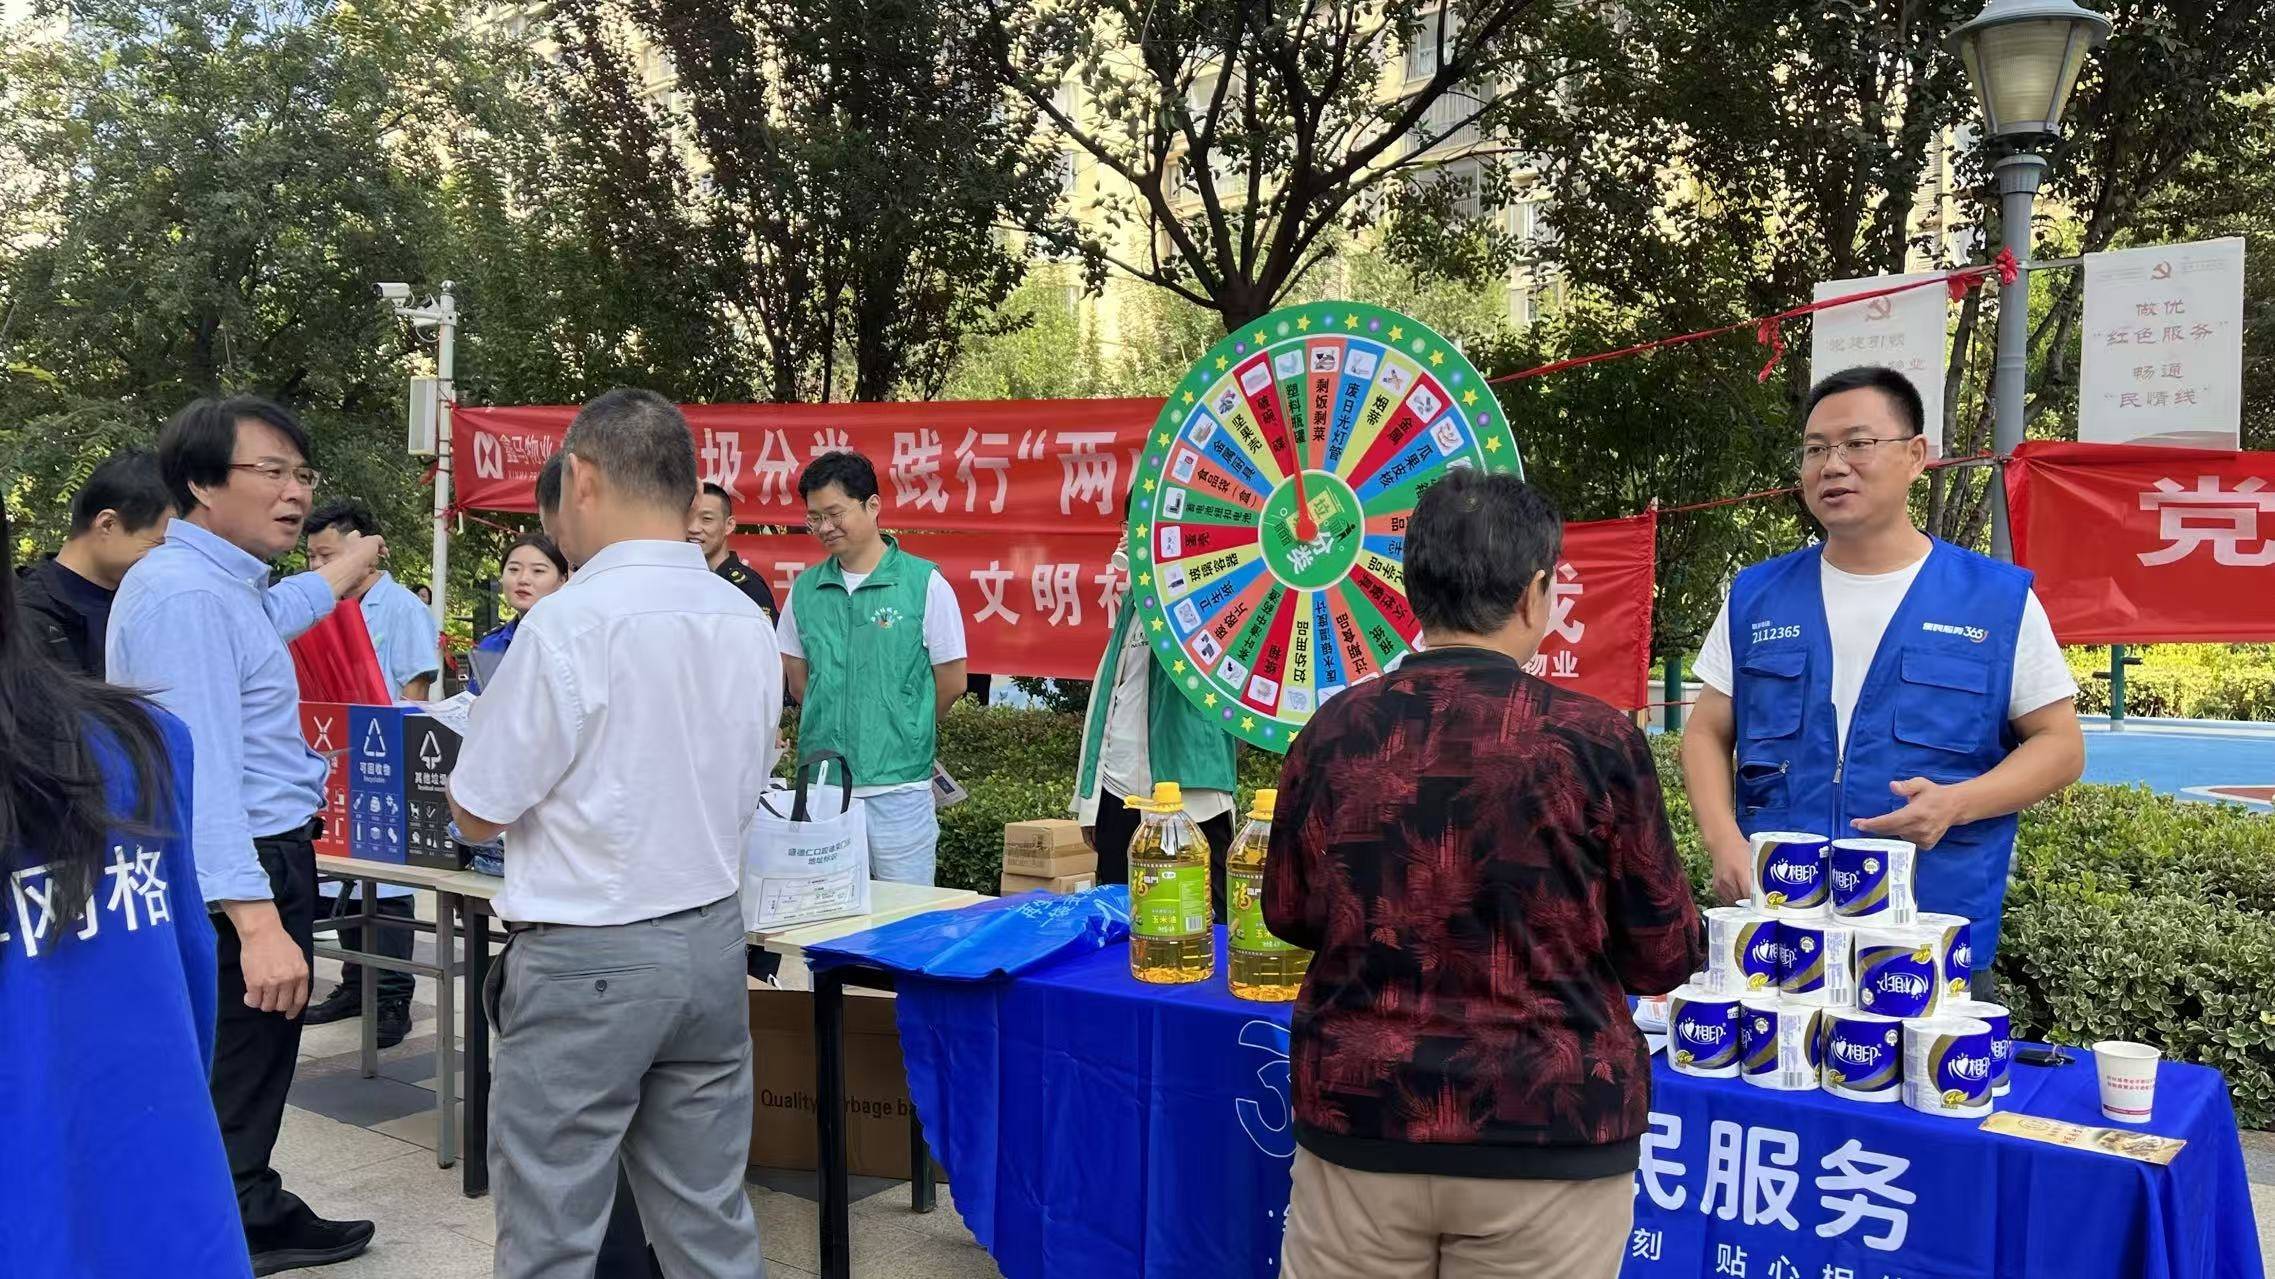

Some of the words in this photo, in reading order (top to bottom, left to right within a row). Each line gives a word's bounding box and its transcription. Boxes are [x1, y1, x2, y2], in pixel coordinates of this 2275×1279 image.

[2136, 299, 2185, 316] 做优
[2133, 362, 2184, 381] 畅通
[1312, 378, 1329, 442] 剩饭剩菜
[1328, 382, 1360, 462] 废日光灯管
[1366, 394, 1389, 426] 烟蒂
[1231, 413, 1263, 455] 坚果壳
[1387, 416, 1414, 447] 金属
[889, 426, 1148, 516] 践行“两
[1213, 438, 1256, 482] 金属厨具
[1378, 444, 1433, 488] 瓜果皮核
[1184, 531, 1209, 548] 蛋壳
[2136, 475, 2275, 567] 党
[1190, 552, 1240, 583] 玻璃容器
[1199, 579, 1235, 613] 卫生纸
[1214, 601, 1249, 640] 废胶片
[1238, 588, 1282, 662] 茶叶渣中药渣
[1752, 624, 1801, 645] 2112365
[1263, 644, 1281, 675] 纸箱
[1293, 621, 1309, 684] 妇幼用品
[1314, 599, 1337, 683] 废水银温度计
[1335, 611, 1369, 674] 过期食品
[1367, 626, 1395, 656] 报纸
[360, 761, 391, 777] 可回收物
[0, 844, 170, 957] 网格
[1152, 915, 1177, 924] 玉米油
[760, 1088, 818, 1115] Quality
[1632, 1111, 1917, 1252] 民服务
